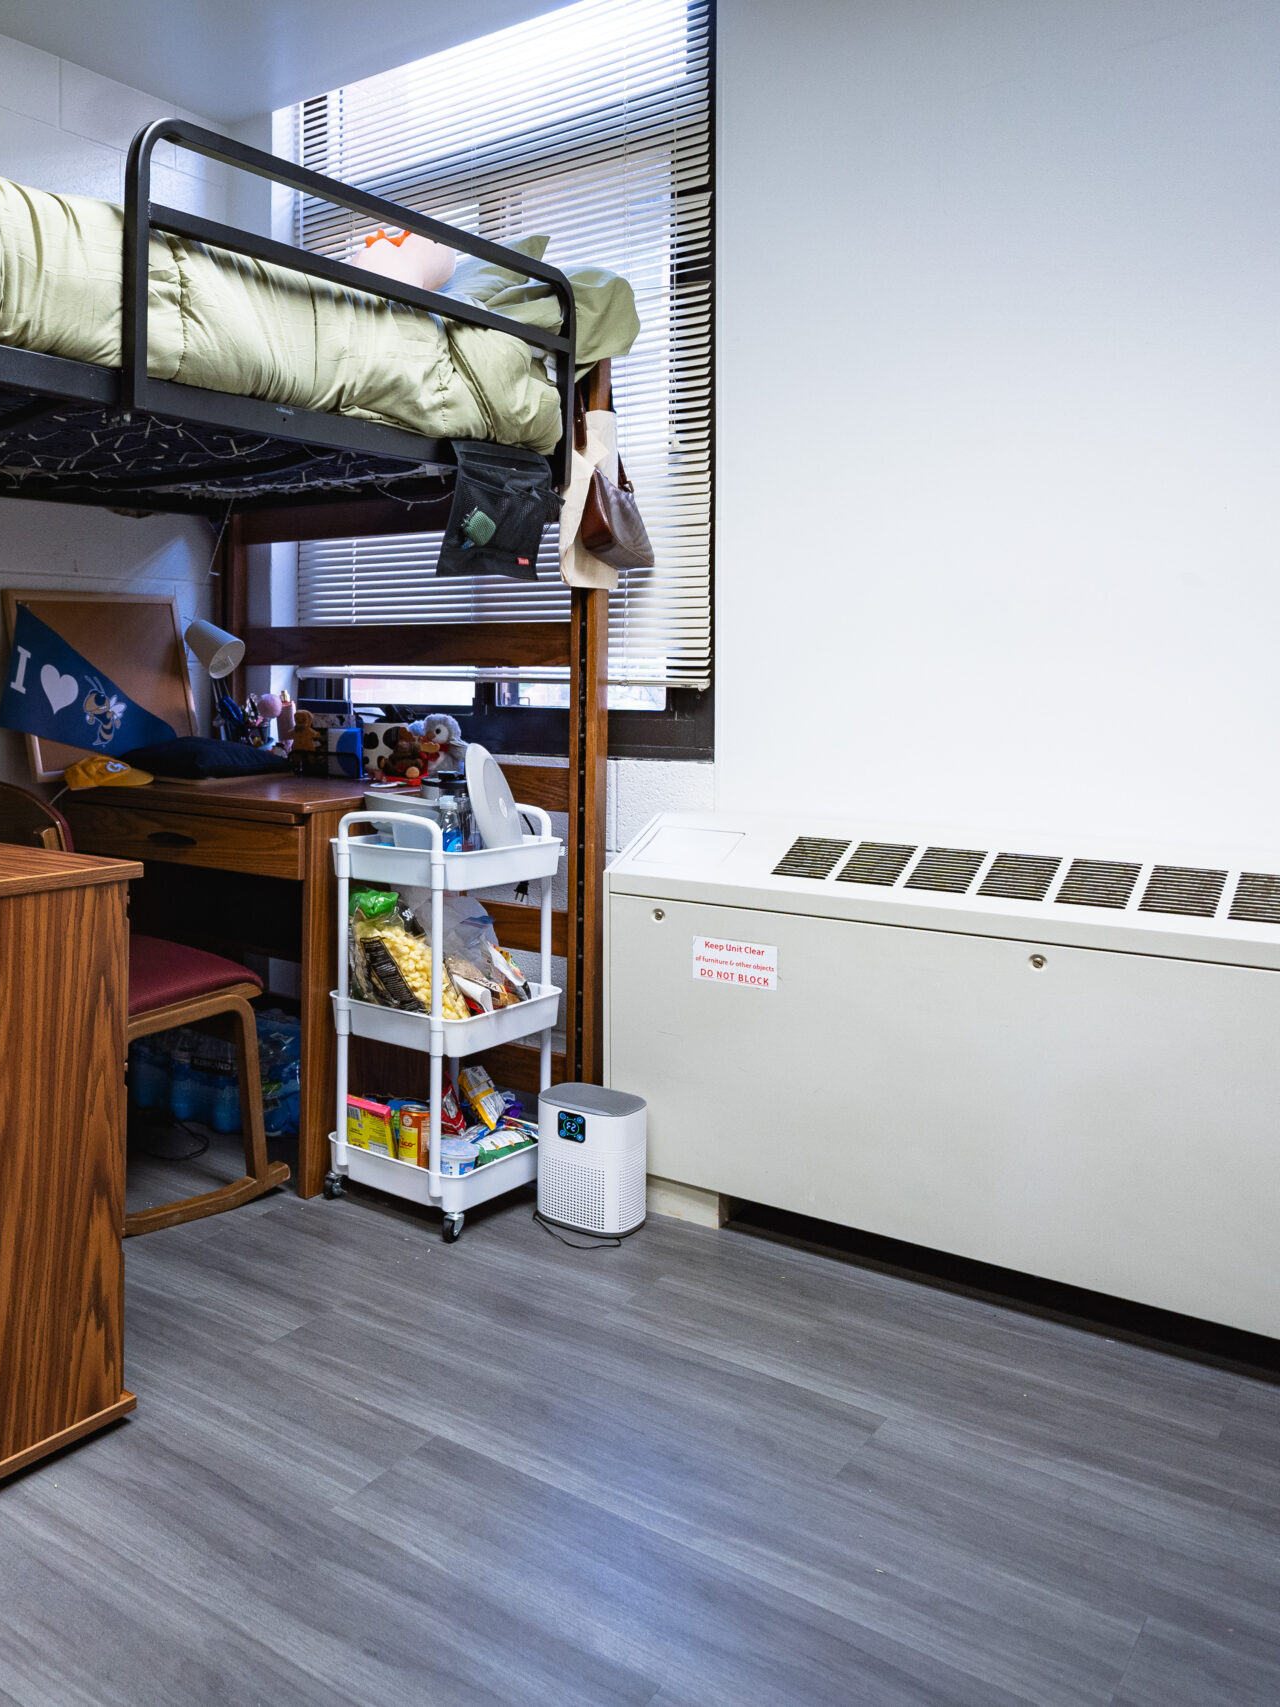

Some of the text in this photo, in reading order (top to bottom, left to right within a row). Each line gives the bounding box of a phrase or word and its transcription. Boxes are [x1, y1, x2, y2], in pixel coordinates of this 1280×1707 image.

[10, 645, 31, 694] I
[704, 941, 765, 956] Keep Unit Clear
[702, 956, 728, 965] furniture
[752, 964, 775, 972] objects
[700, 968, 769, 986] DO NOT BLOCK
